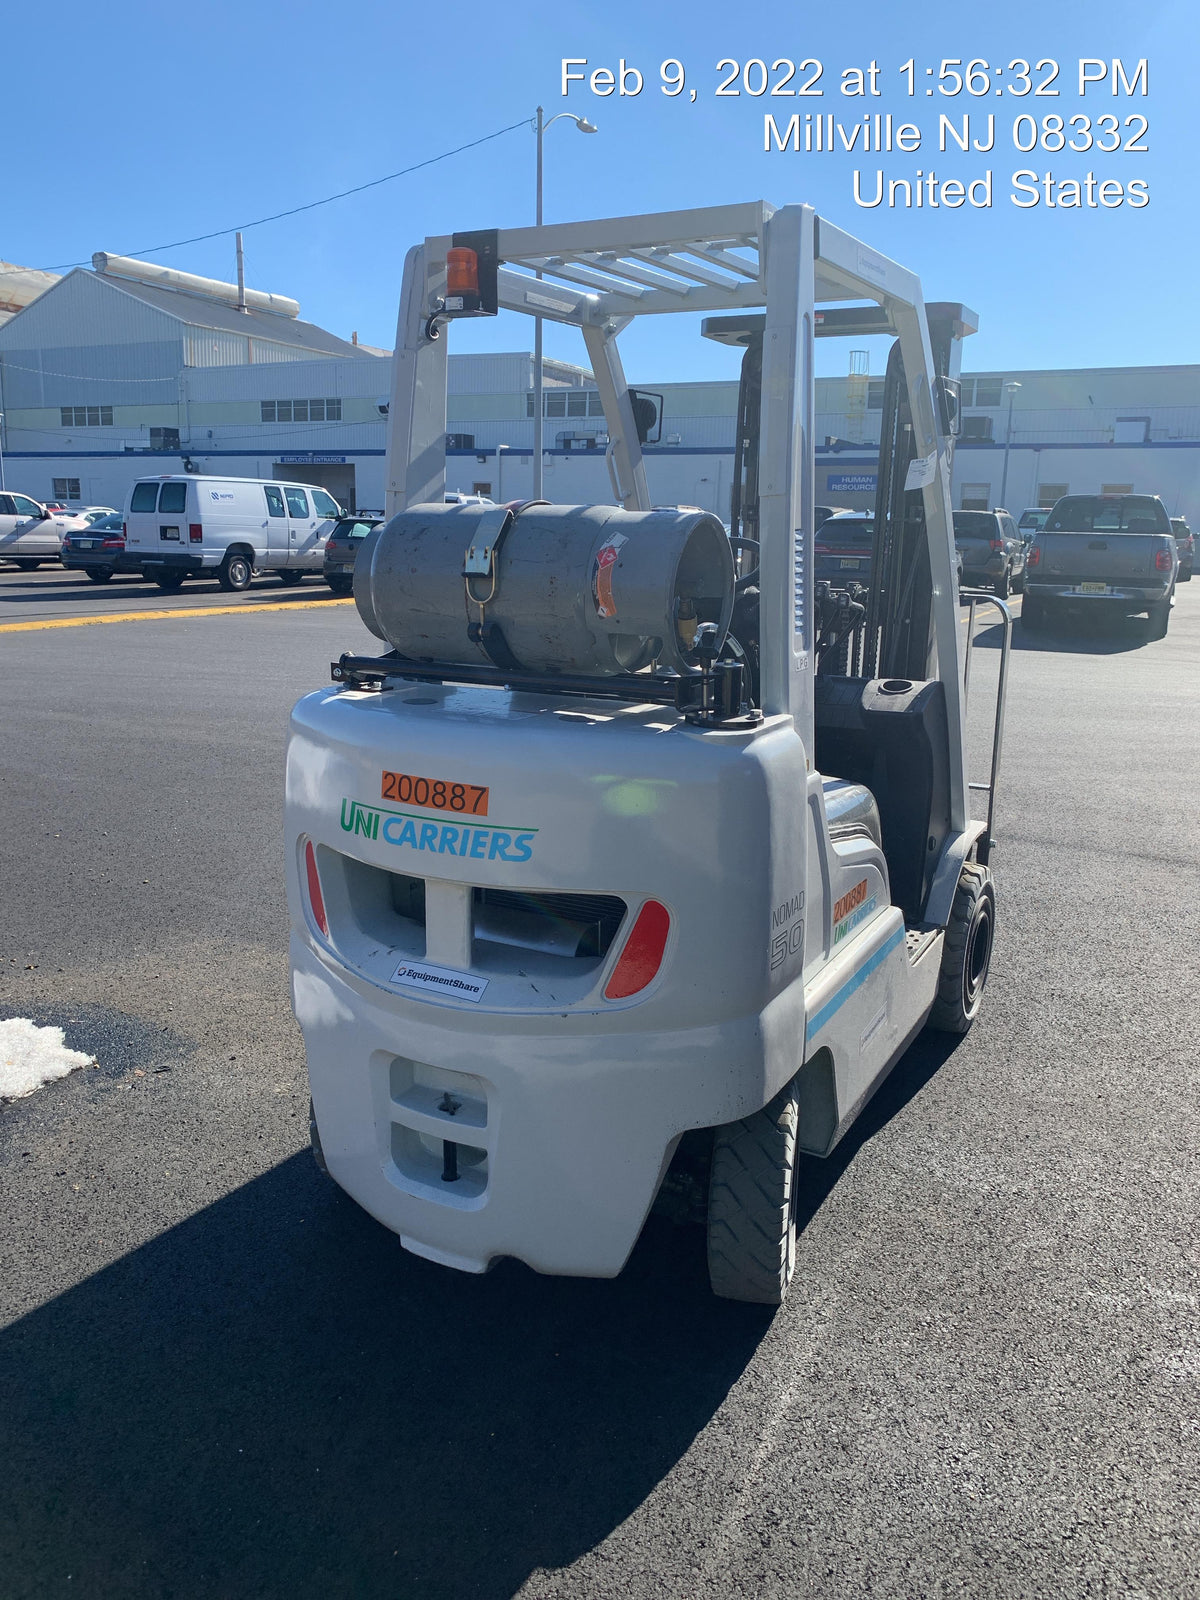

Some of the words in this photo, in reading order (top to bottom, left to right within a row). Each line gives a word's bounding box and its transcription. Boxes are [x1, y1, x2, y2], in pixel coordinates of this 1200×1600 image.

[382, 772, 487, 813] 200887
[772, 890, 805, 931] NOMAD
[770, 918, 805, 971] 50
[406, 968, 481, 993] EquipmentShare
